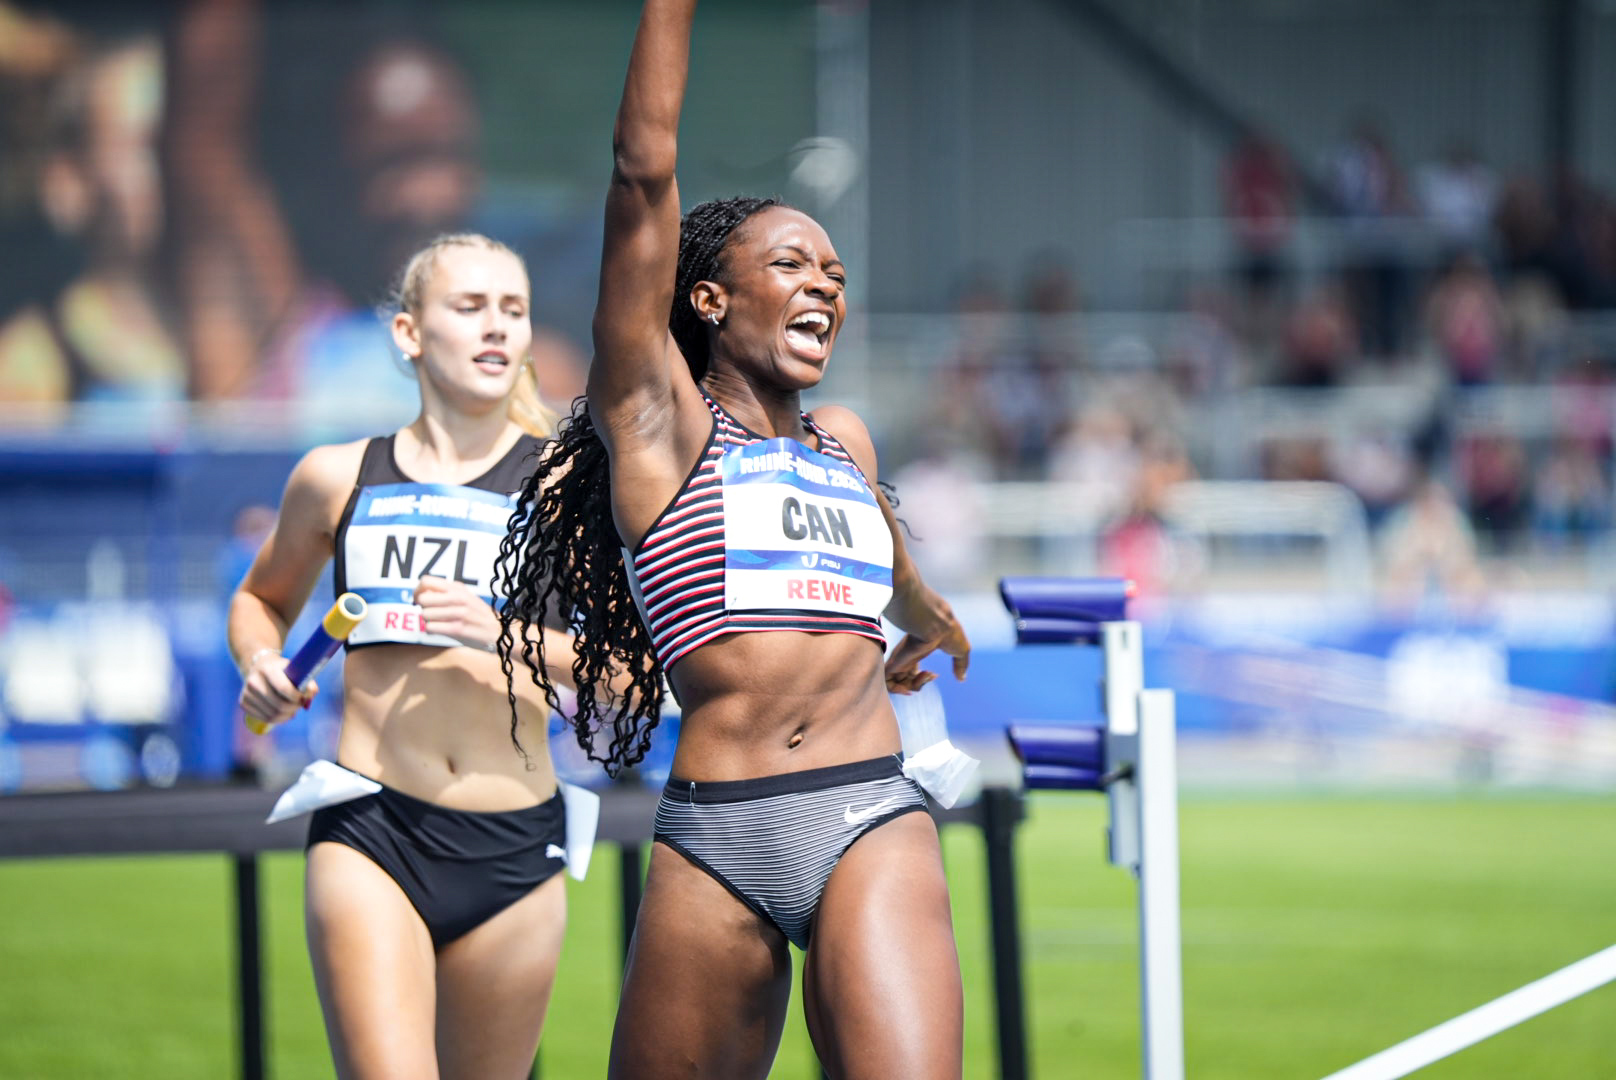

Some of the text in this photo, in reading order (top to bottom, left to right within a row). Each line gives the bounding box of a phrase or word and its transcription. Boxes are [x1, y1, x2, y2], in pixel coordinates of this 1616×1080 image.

[782, 496, 854, 548] CAN
[380, 535, 479, 586] NZL
[787, 578, 855, 606] REWE
